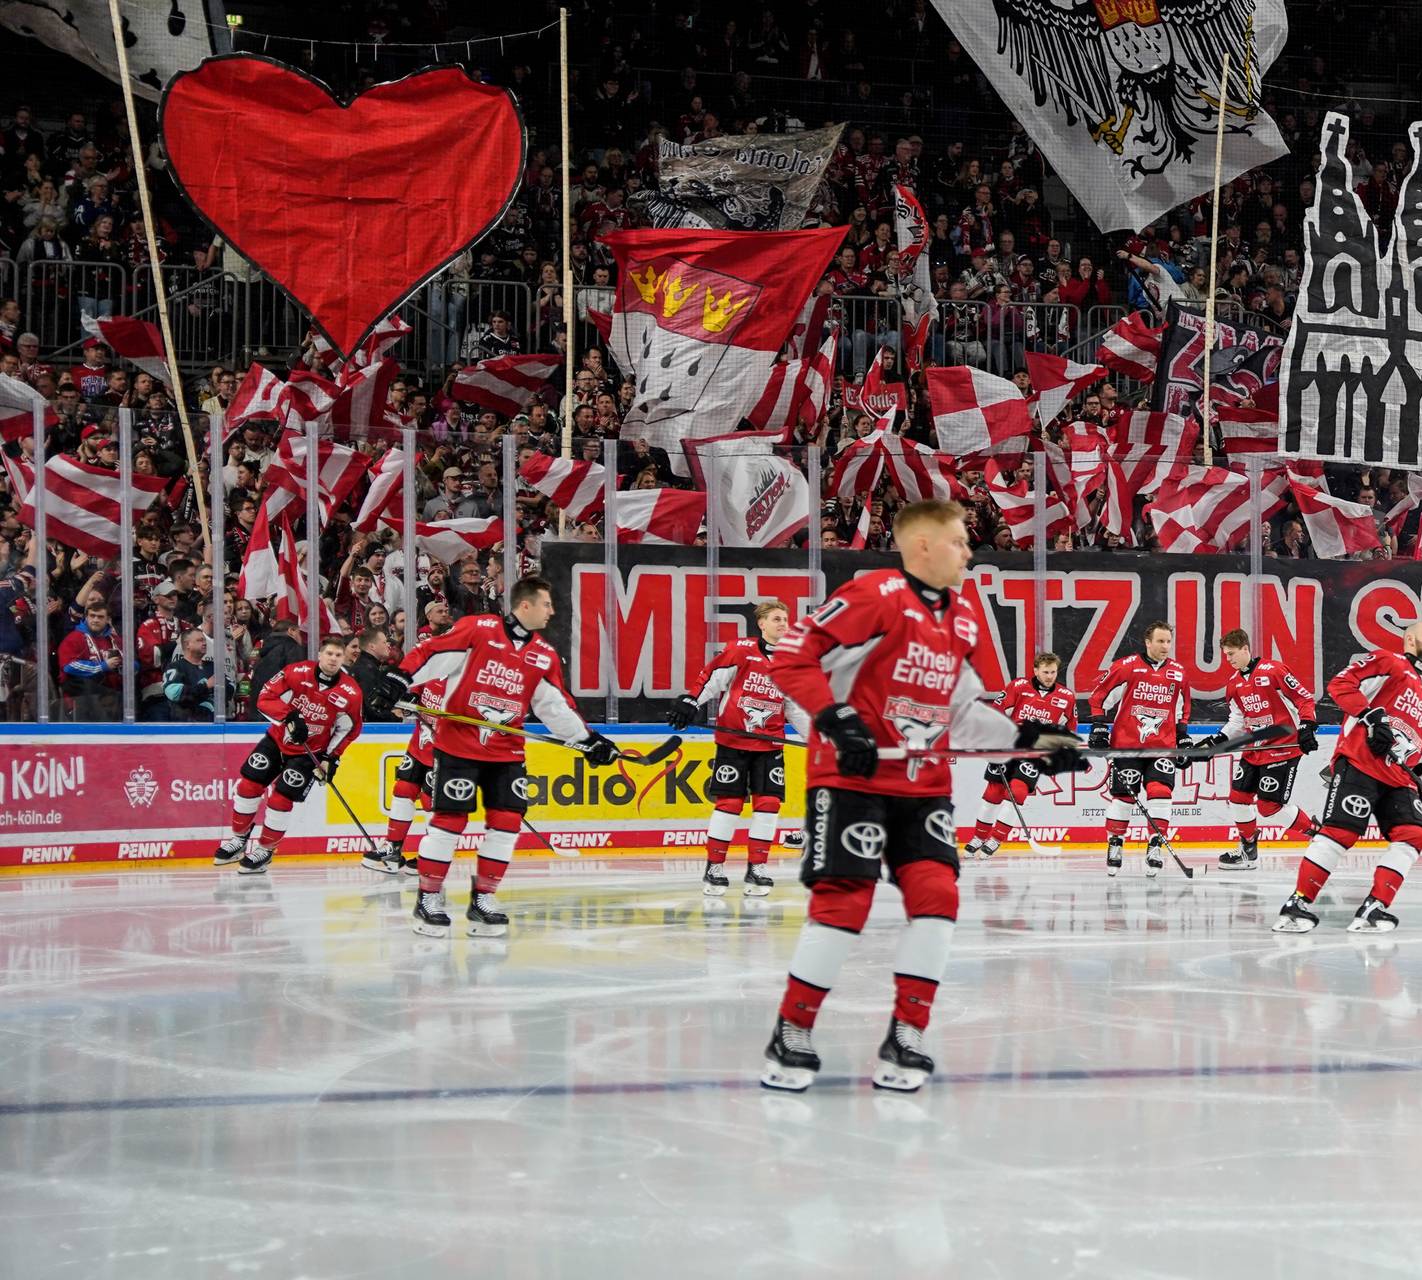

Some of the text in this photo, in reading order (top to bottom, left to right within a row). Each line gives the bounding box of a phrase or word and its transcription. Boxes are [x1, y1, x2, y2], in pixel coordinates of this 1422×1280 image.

[1167, 572, 1323, 699] UN
[486, 660, 523, 682] Rhein
[748, 671, 777, 687] Rhe
[476, 669, 524, 695] Energie
[1138, 682, 1168, 695] Rhein
[299, 694, 327, 713] Rhein
[1133, 689, 1172, 704] Energie
[1023, 704, 1051, 719] Rhein
[11, 752, 84, 800] KÖLN!
[527, 757, 637, 806] adio
[170, 778, 224, 802] Stadt
[1082, 808, 1106, 816] JETZT
[662, 831, 709, 846] PENN
[813, 814, 829, 871] TOYOTA
